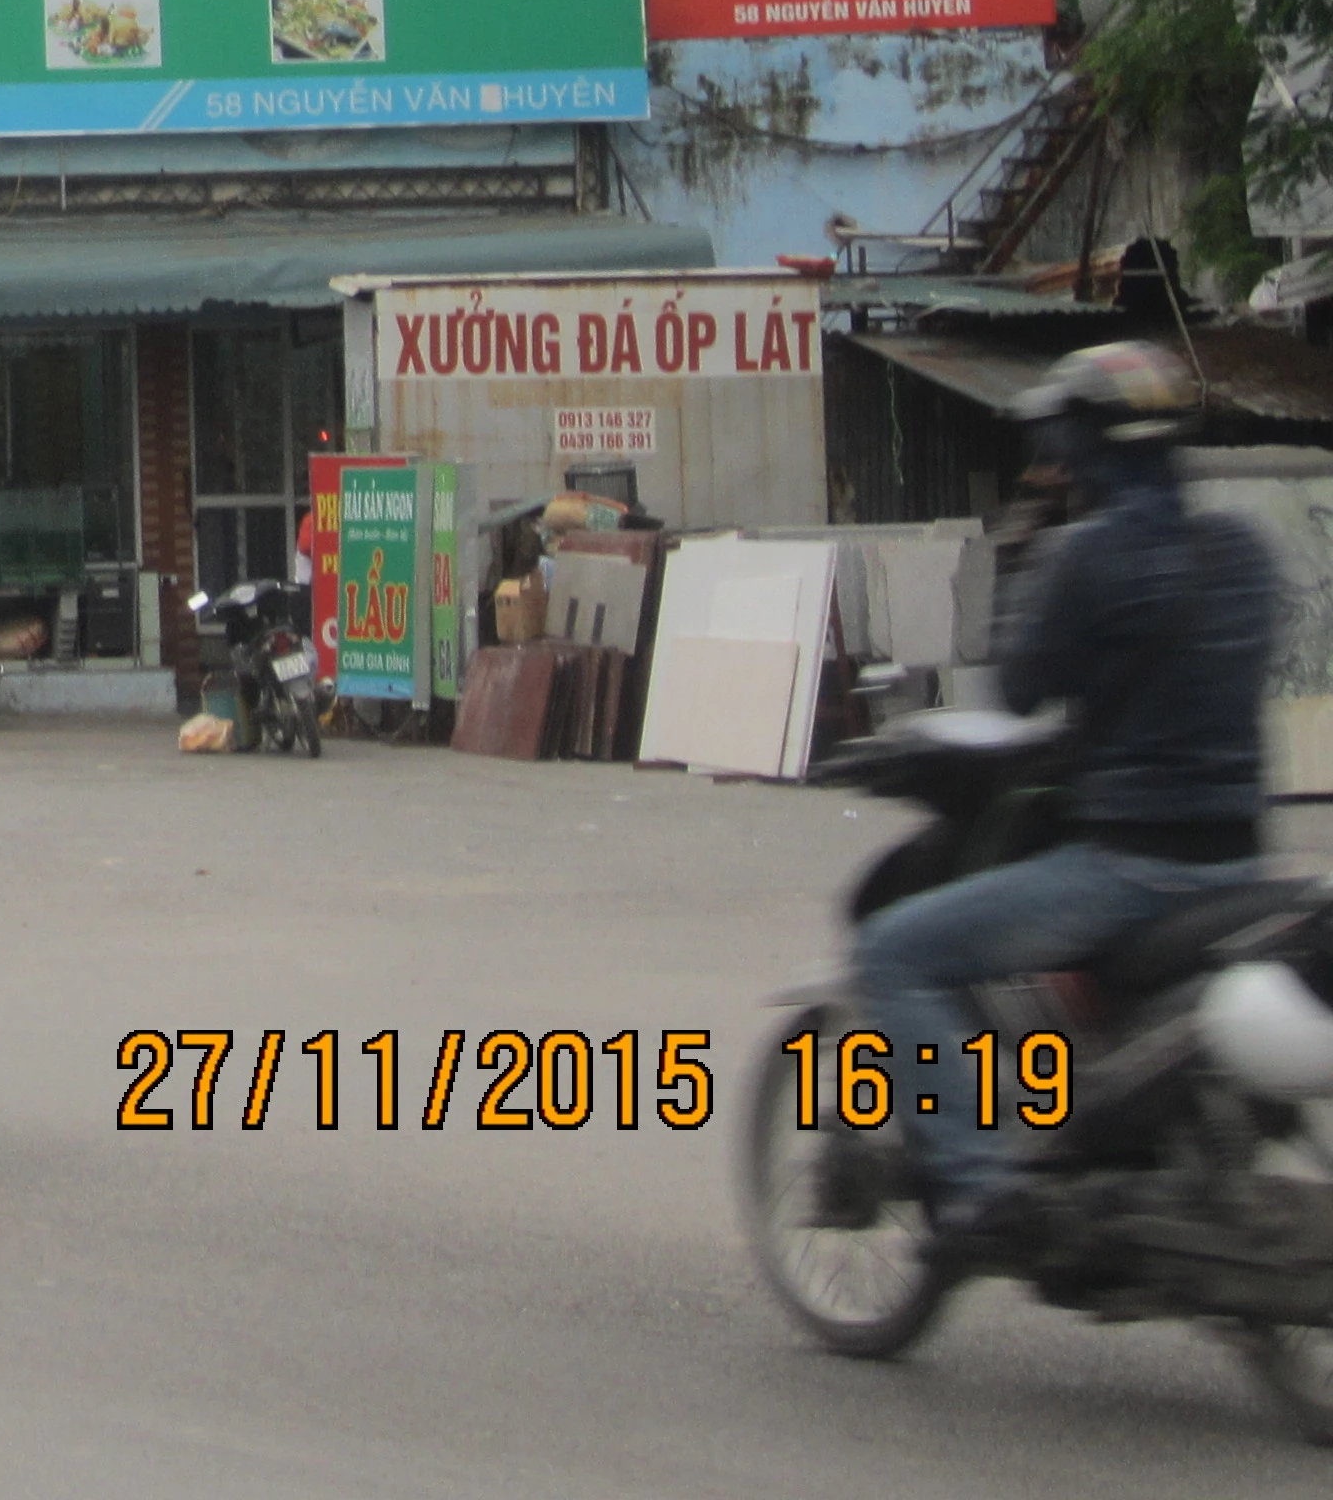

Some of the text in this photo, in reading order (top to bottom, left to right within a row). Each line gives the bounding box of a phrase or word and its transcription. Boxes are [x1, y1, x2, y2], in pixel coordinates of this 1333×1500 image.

[207, 77, 615, 118] 58 NGUYỄN VĂN HUYÊN
[396, 289, 816, 375] XƯỞNG ĐÁ ỐP LÁT
[345, 547, 408, 644] LẨU
